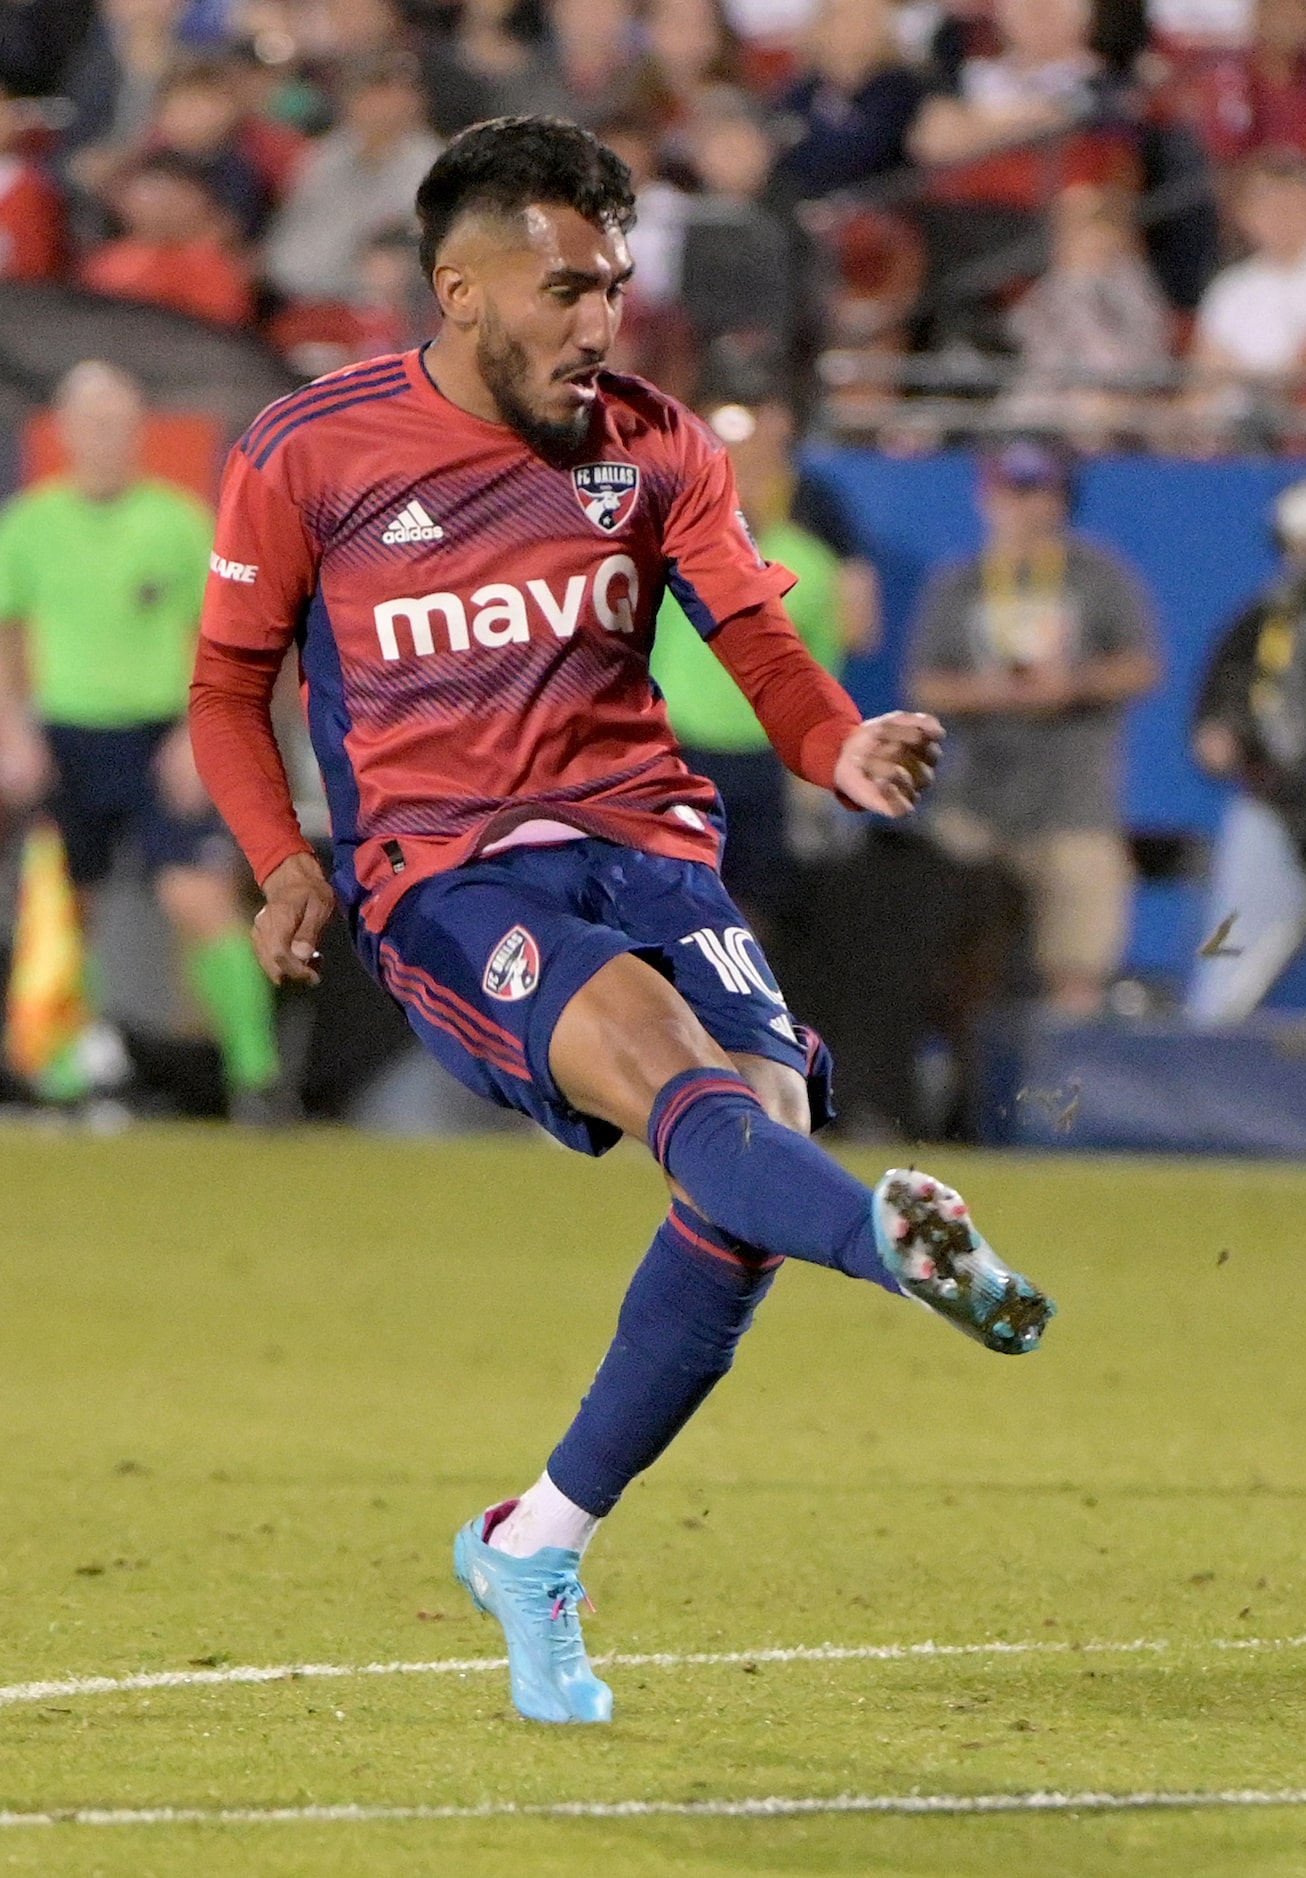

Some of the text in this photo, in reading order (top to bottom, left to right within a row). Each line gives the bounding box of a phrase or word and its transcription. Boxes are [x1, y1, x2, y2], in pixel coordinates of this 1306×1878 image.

[577, 466, 634, 486] FC DALLAS
[382, 526, 444, 544] adidas
[679, 926, 788, 1012] 10
